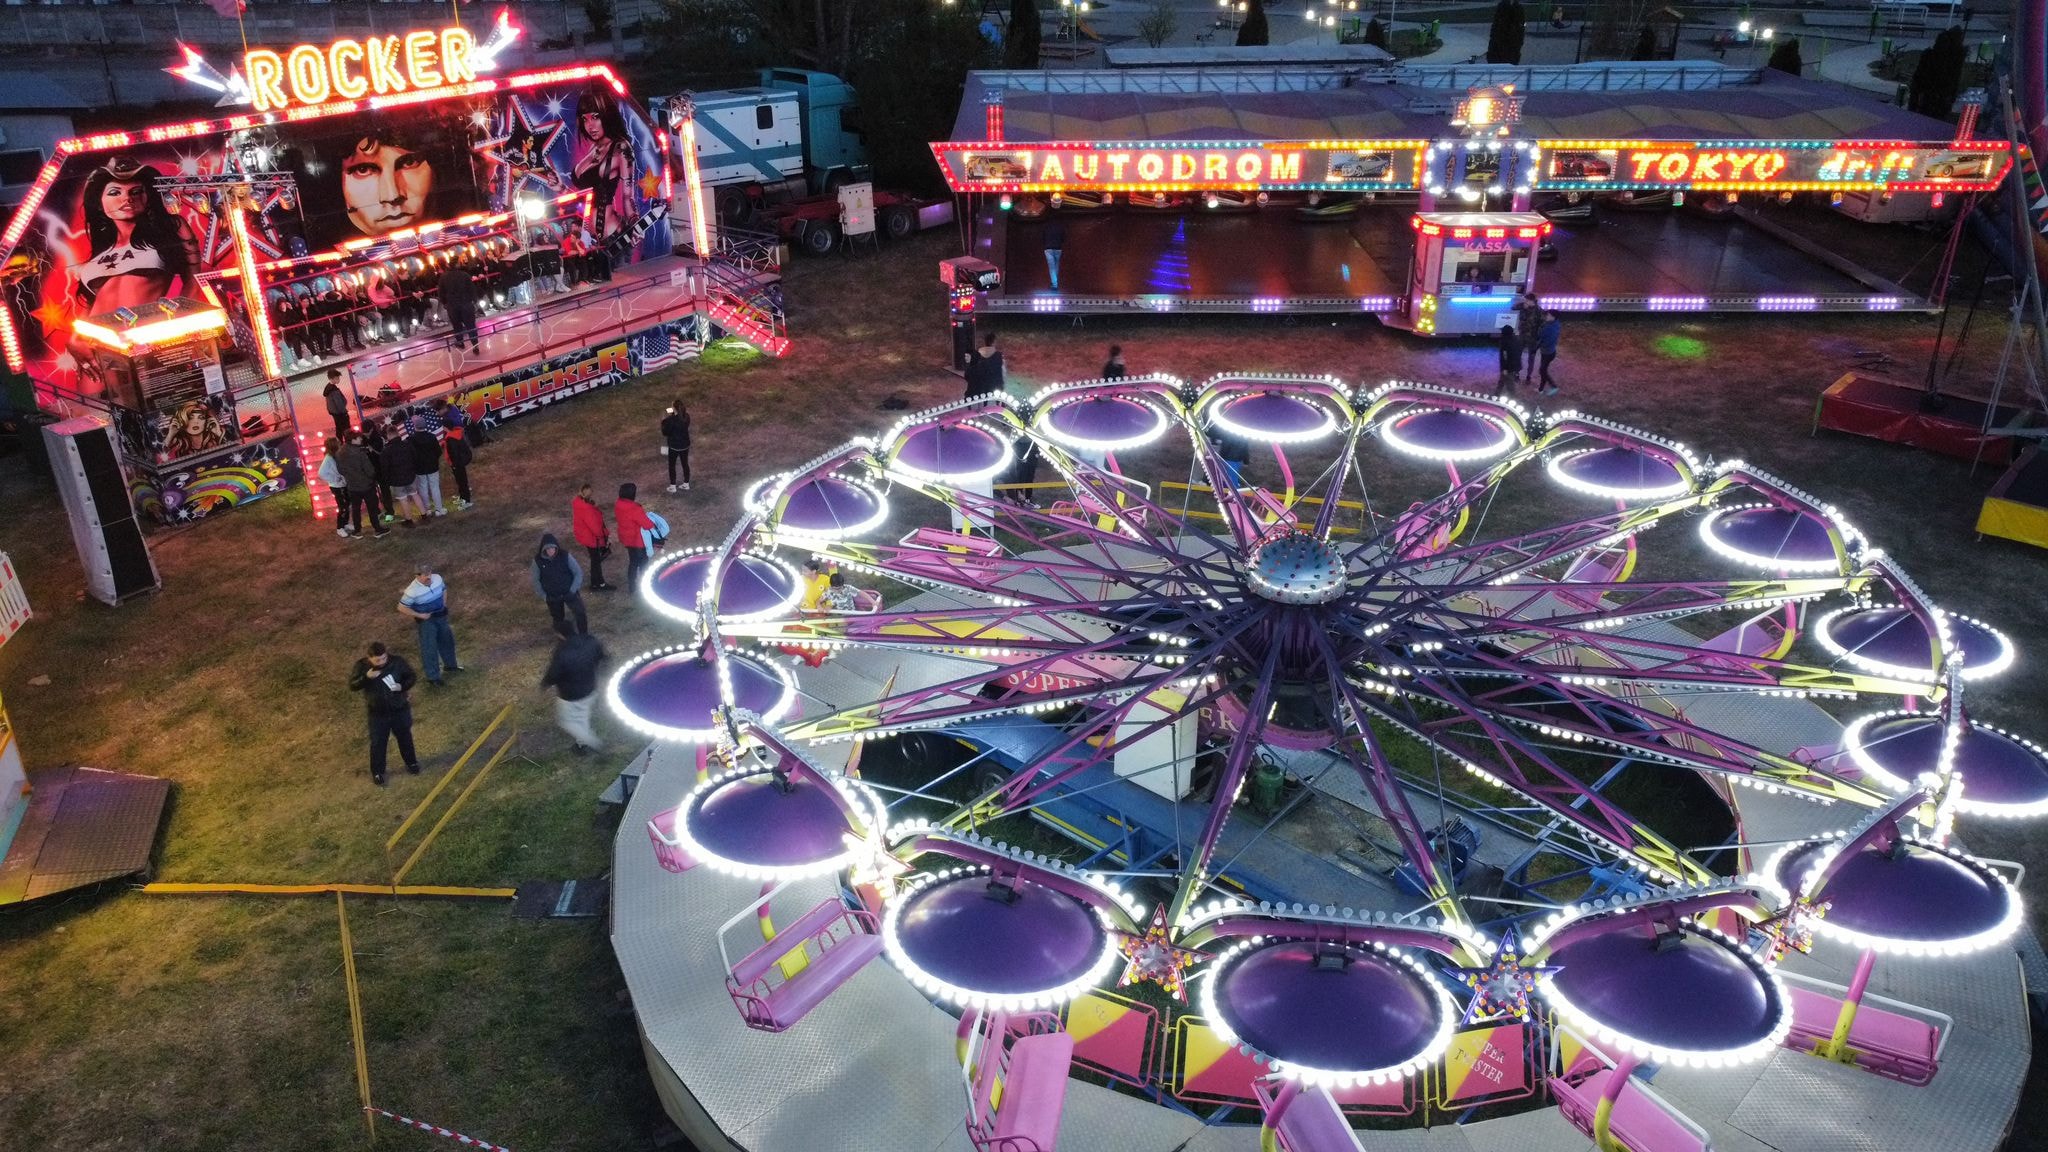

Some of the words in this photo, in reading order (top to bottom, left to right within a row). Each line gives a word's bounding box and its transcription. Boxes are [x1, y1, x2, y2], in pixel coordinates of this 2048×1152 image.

[244, 27, 476, 111] ROCKER
[1456, 100, 1519, 122] MGA
[1040, 153, 1301, 181] AUTODROM
[1632, 152, 1784, 180] TOKYO
[1818, 152, 1914, 185] drift
[1463, 241, 1513, 252] KASSA
[457, 341, 631, 424] ROCKER
[501, 373, 612, 419] EXTREM
